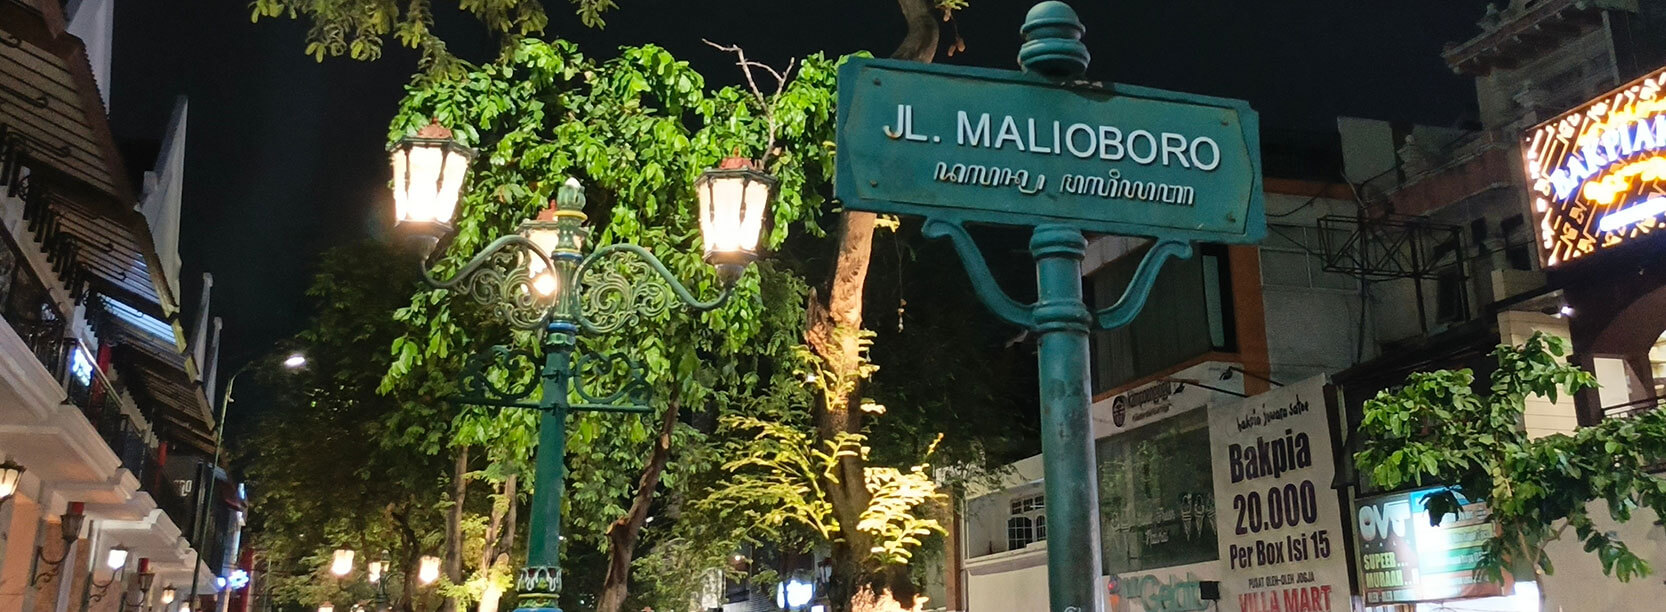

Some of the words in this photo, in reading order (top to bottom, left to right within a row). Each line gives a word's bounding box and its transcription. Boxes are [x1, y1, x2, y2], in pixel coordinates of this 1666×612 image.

[883, 104, 941, 142] JL.
[957, 110, 1221, 171] MALIOBORO
[1229, 428, 1312, 484] Bakpia
[1233, 480, 1317, 535] 20.000
[1230, 544, 1254, 570] Per
[1256, 540, 1285, 566] Box
[1287, 533, 1308, 562] Isi
[1310, 530, 1331, 559] 15
[1238, 590, 1281, 612] VILLA
[1283, 585, 1332, 612] MART
